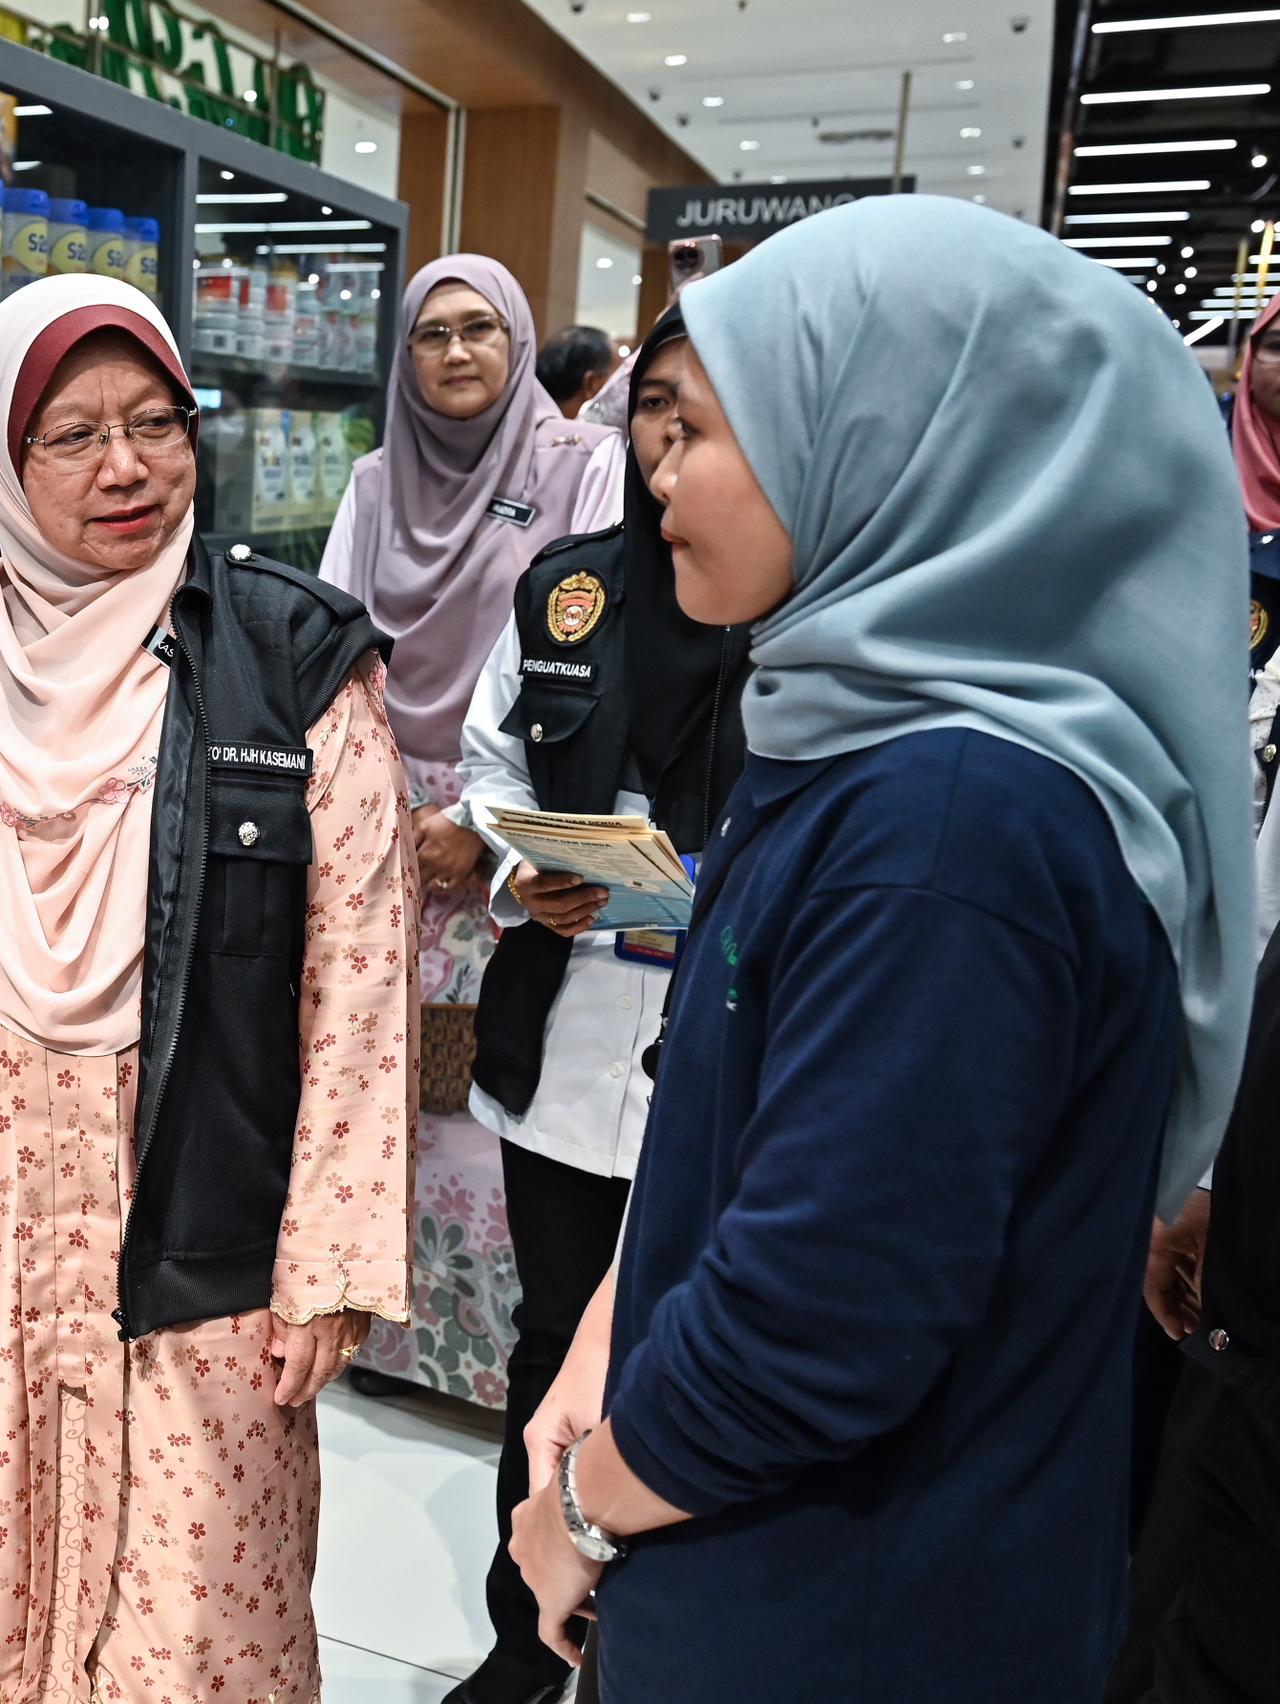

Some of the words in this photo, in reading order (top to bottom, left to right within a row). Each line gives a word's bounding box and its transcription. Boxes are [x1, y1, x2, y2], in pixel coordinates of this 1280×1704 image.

[523, 659, 591, 678] PENGUATKUASA
[223, 747, 238, 762] DR.
[241, 748, 259, 764] HJH
[260, 750, 306, 770] KASEMANI
